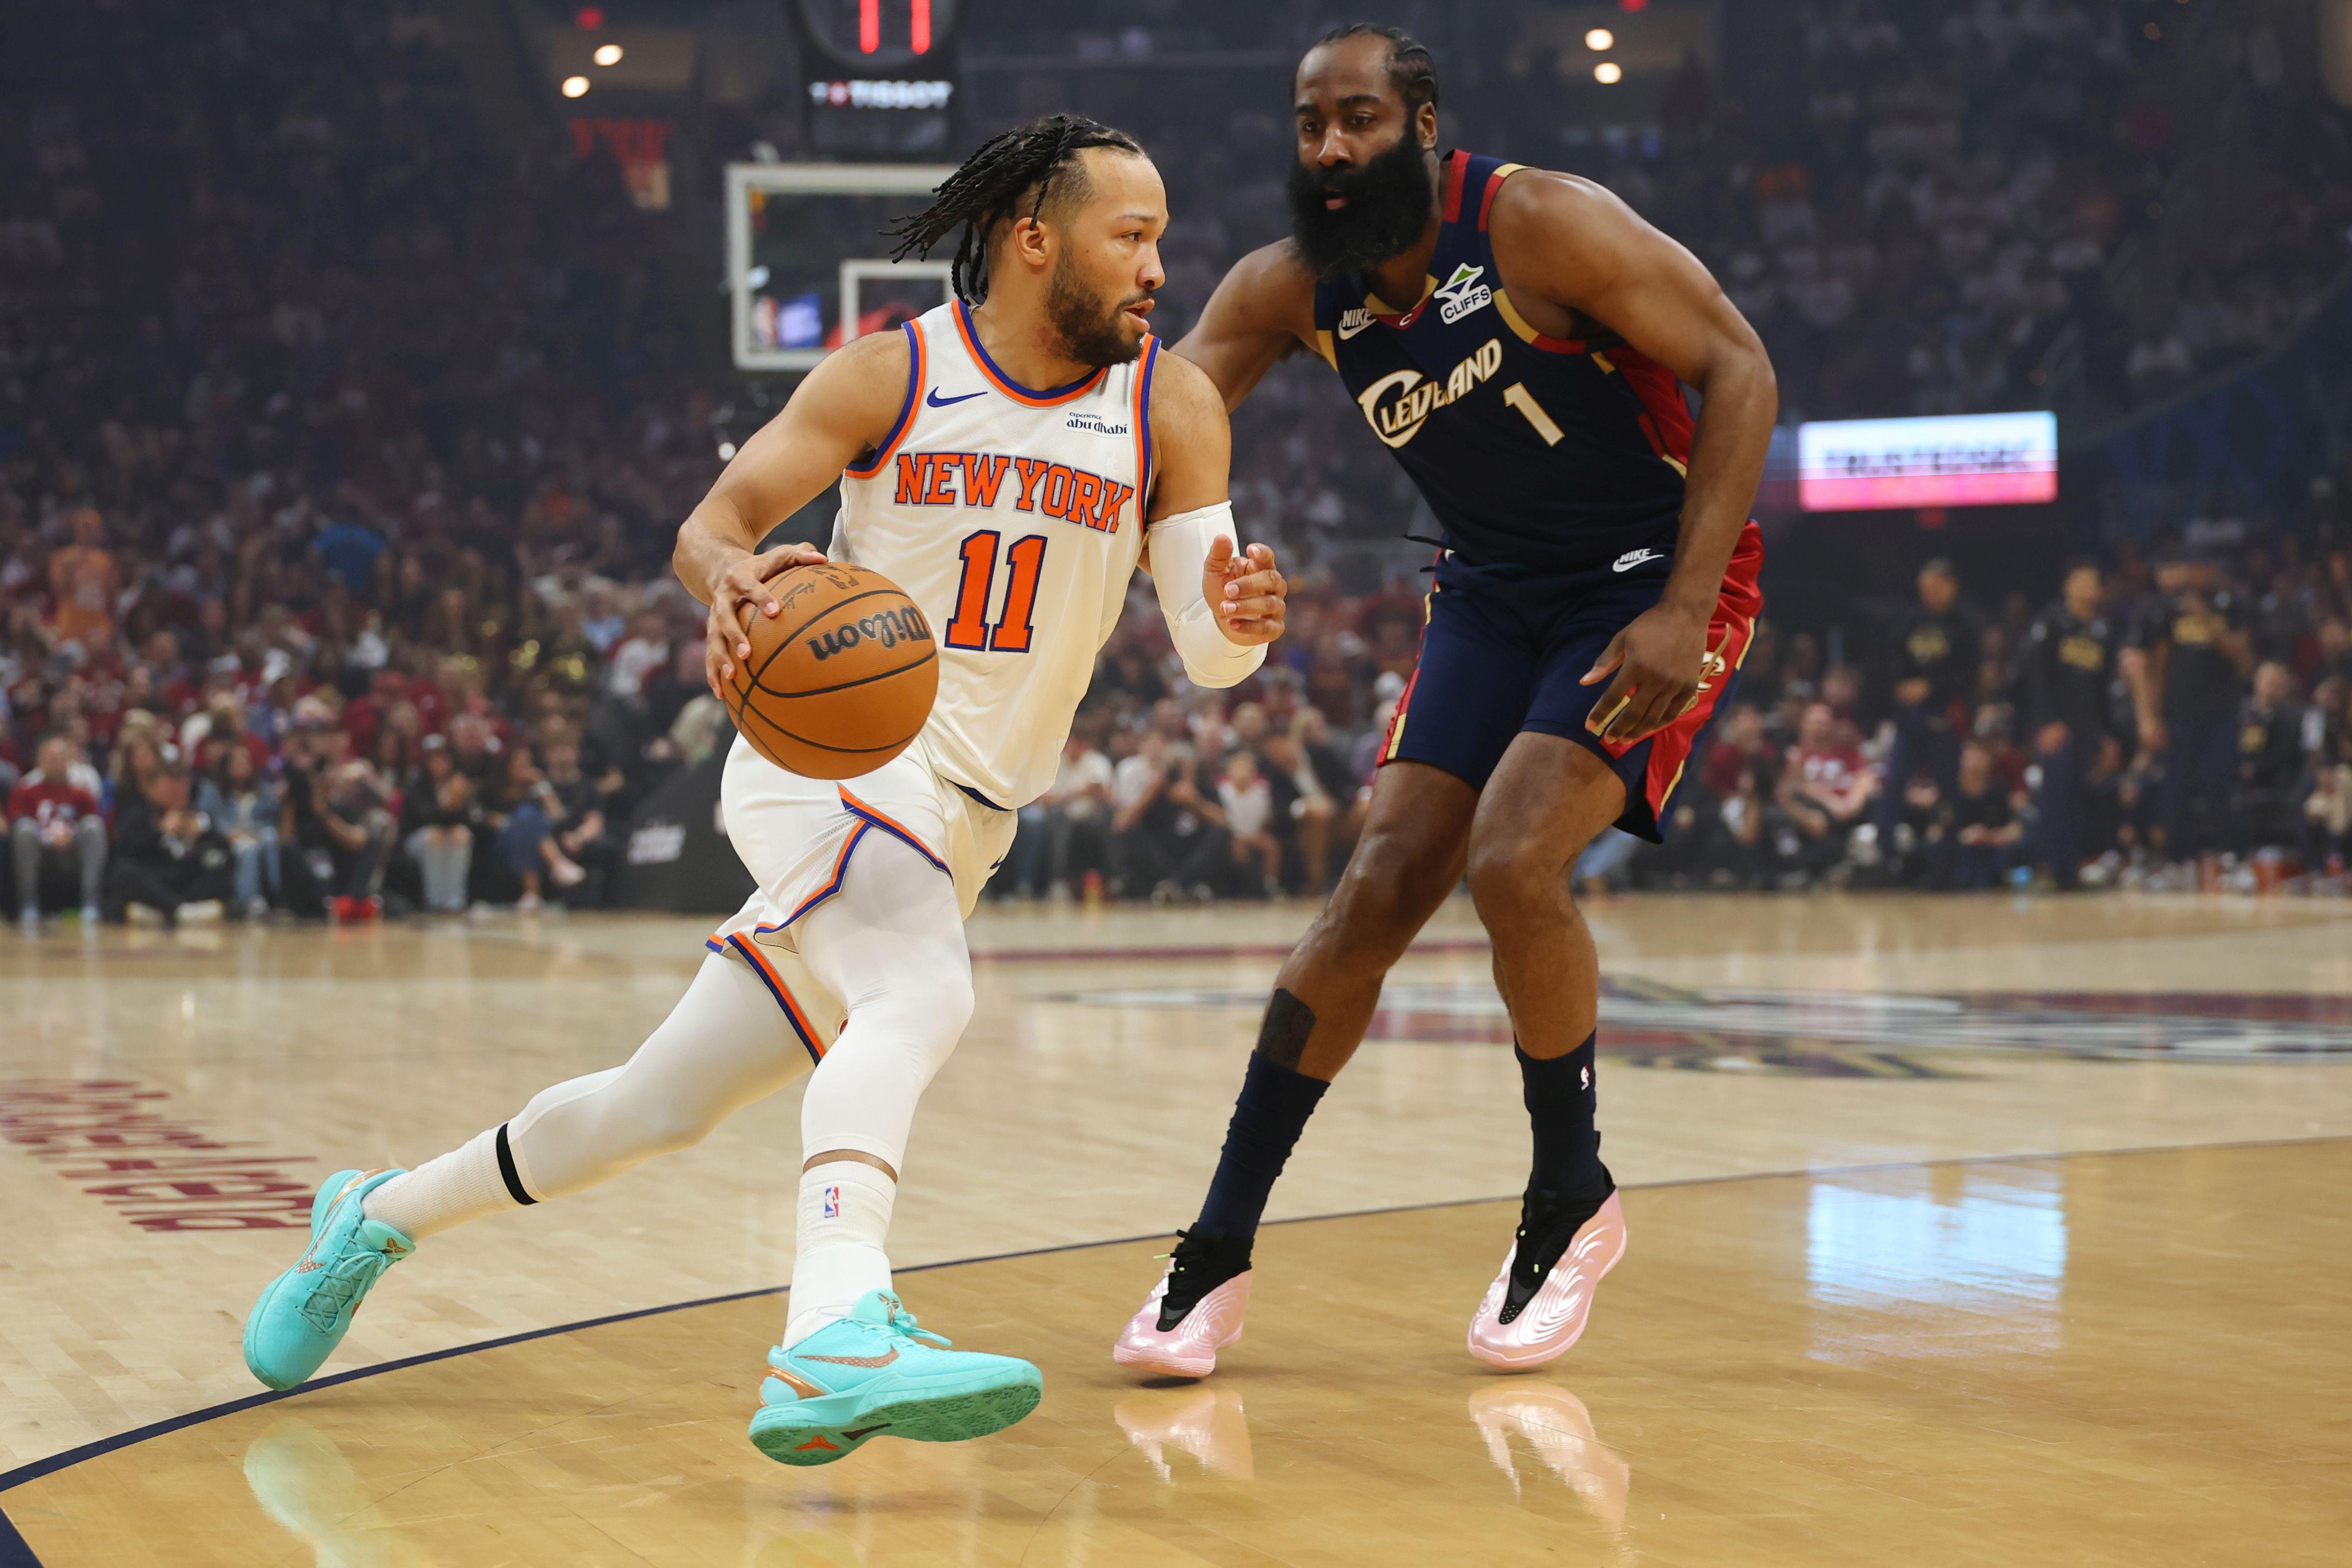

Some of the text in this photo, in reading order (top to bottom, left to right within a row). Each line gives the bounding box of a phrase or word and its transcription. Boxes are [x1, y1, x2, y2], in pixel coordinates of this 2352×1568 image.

[1342, 308, 1371, 328] NIKE
[1444, 289, 1490, 319] CLIFFS
[1358, 338, 1503, 448] CLEVEAND
[1503, 382, 1565, 447] 1
[1067, 419, 1128, 434] abu dhabi
[1069, 412, 1102, 420] experience
[894, 451, 1136, 535] NEW YORK
[1619, 548, 1651, 563] NIKE
[945, 529, 1048, 653] 11
[806, 605, 931, 661] Wilson
